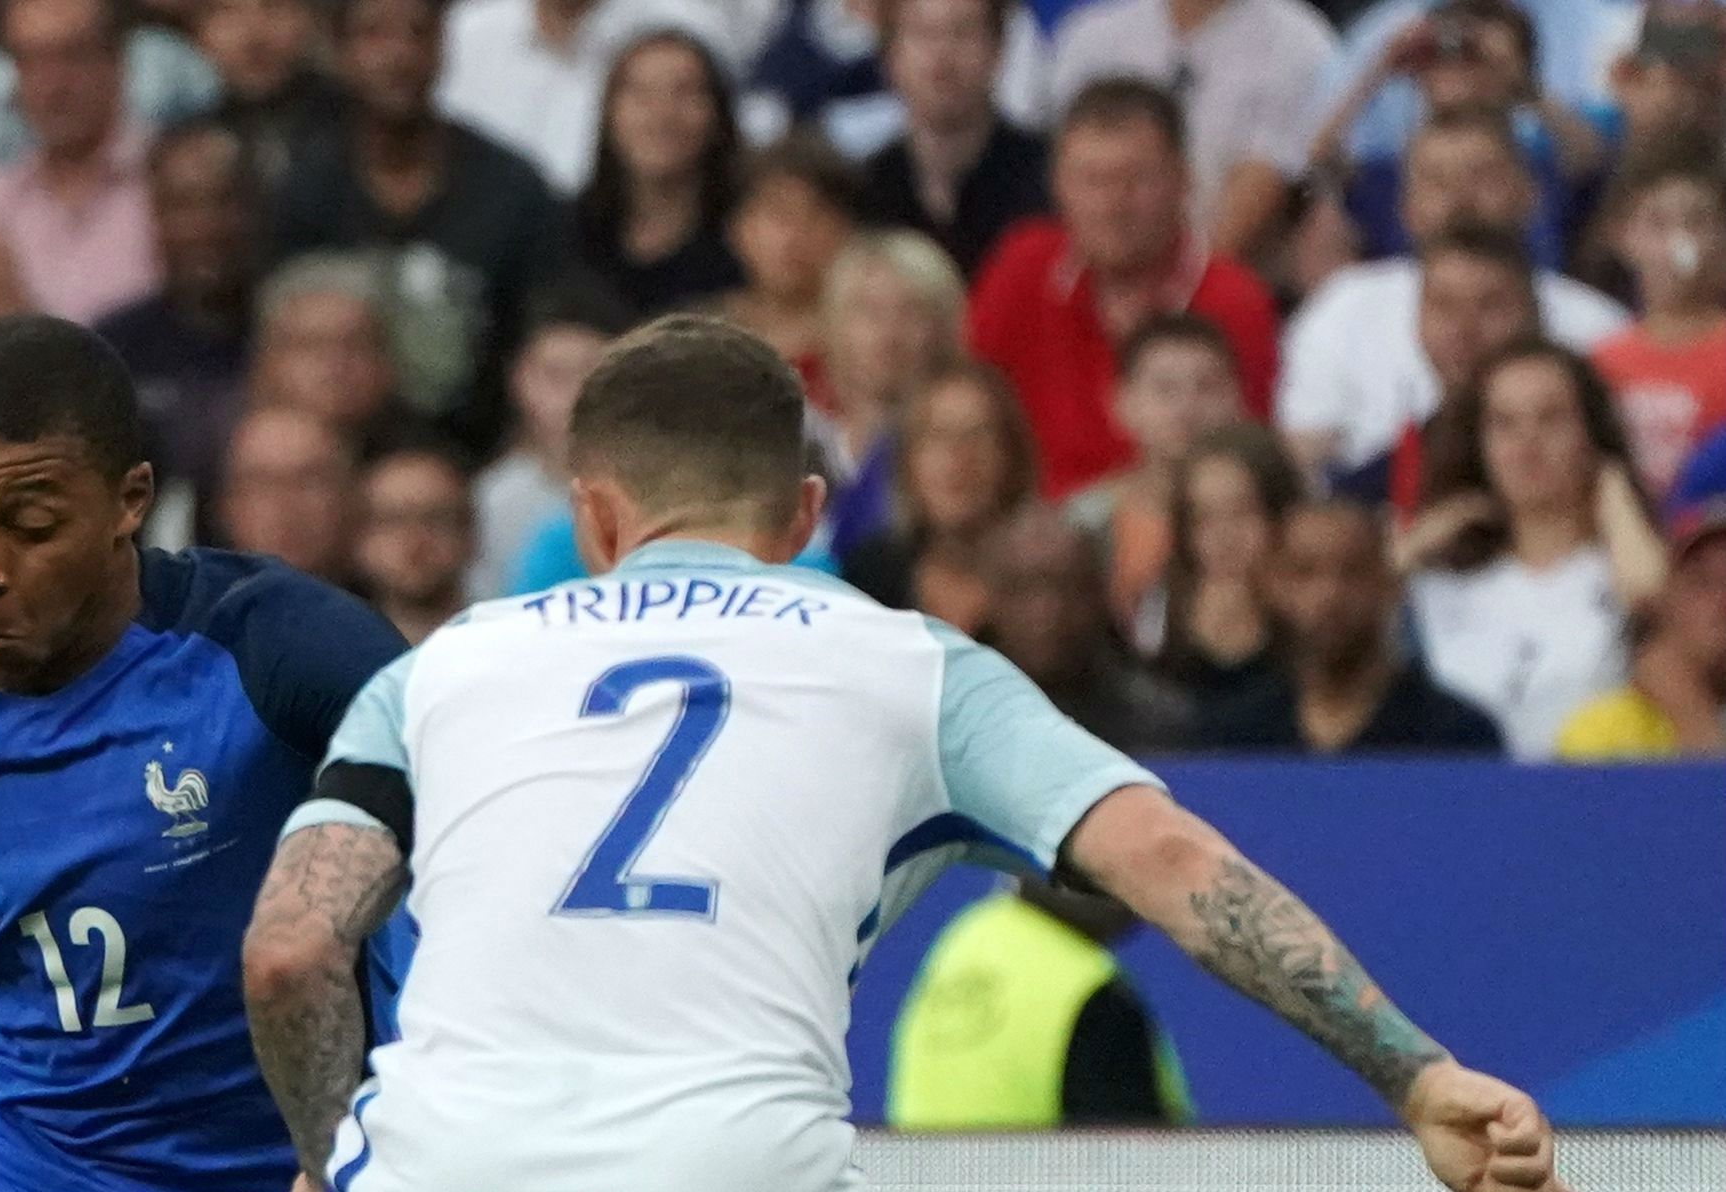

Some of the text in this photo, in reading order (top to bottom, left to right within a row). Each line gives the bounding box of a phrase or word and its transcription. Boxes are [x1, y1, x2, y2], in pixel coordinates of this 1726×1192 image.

[523, 579, 830, 627] TRIPPIER
[548, 655, 732, 925] 2
[18, 906, 156, 1032] 12
